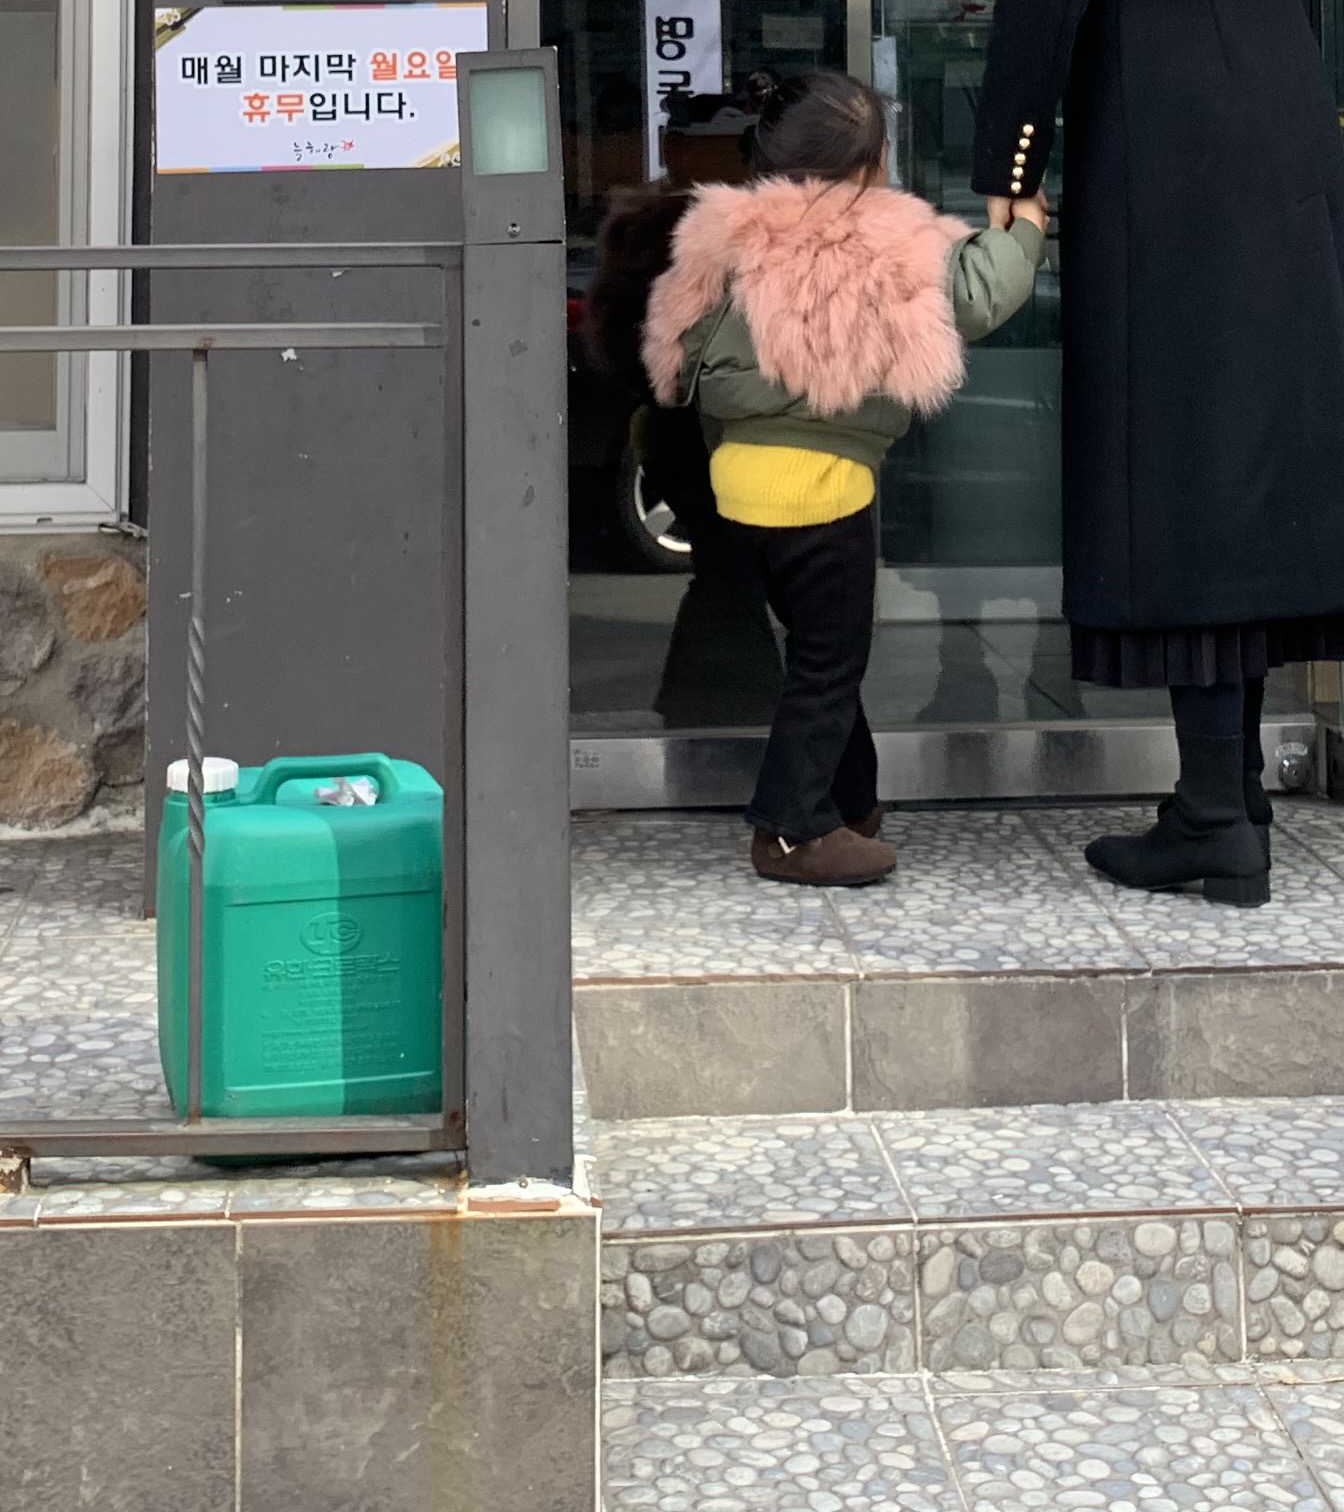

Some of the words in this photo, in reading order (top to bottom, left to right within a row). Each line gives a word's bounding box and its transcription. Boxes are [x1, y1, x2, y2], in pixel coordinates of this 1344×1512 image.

[180, 54, 243, 85] 매월
[259, 53, 357, 84] 마지막
[369, 50, 457, 82] 월요일
[242, 91, 416, 124] 휴무입니다.
